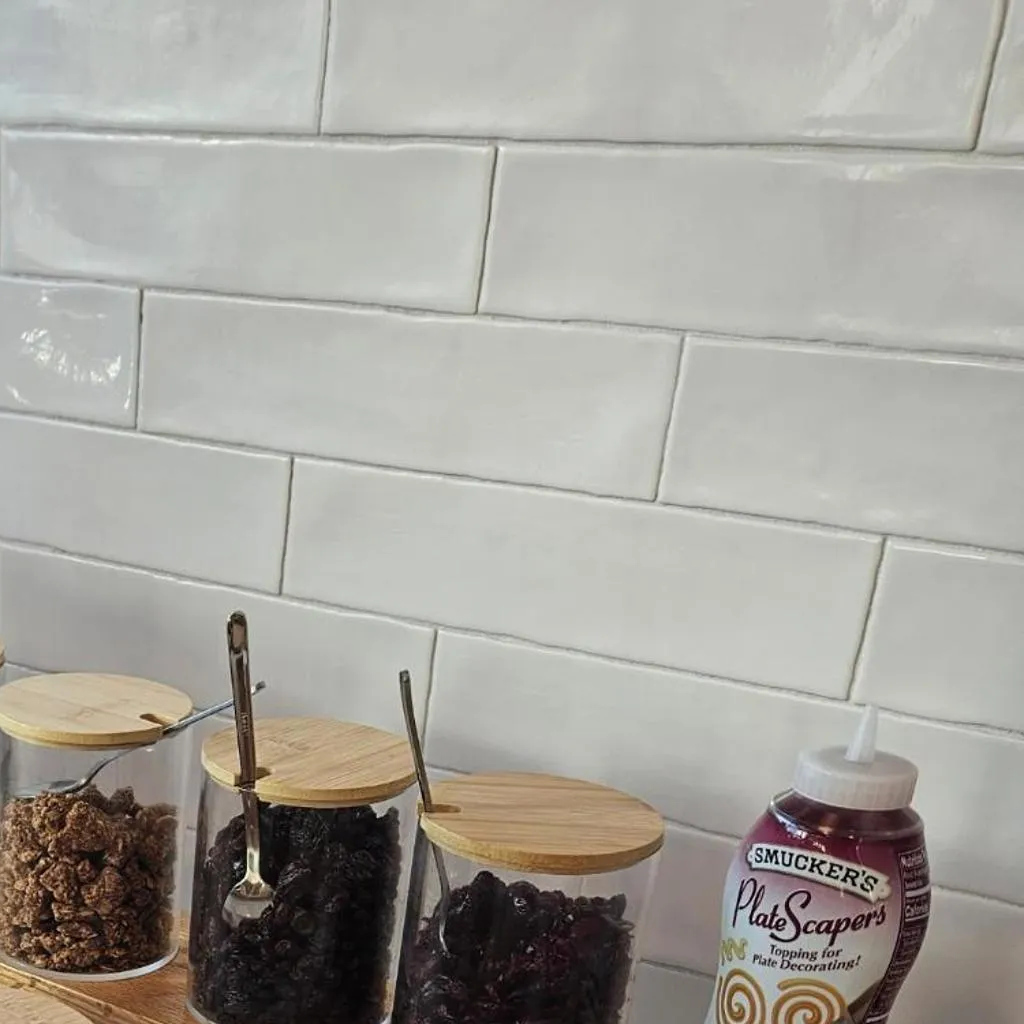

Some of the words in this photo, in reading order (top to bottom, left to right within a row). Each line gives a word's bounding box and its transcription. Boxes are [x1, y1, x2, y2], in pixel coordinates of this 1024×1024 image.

[754, 847, 879, 892] SMUCKER'S
[769, 944, 819, 962] Topping
[821, 946, 843, 958] for
[752, 954, 778, 968] Plate
[779, 955, 862, 973] Decorating!
